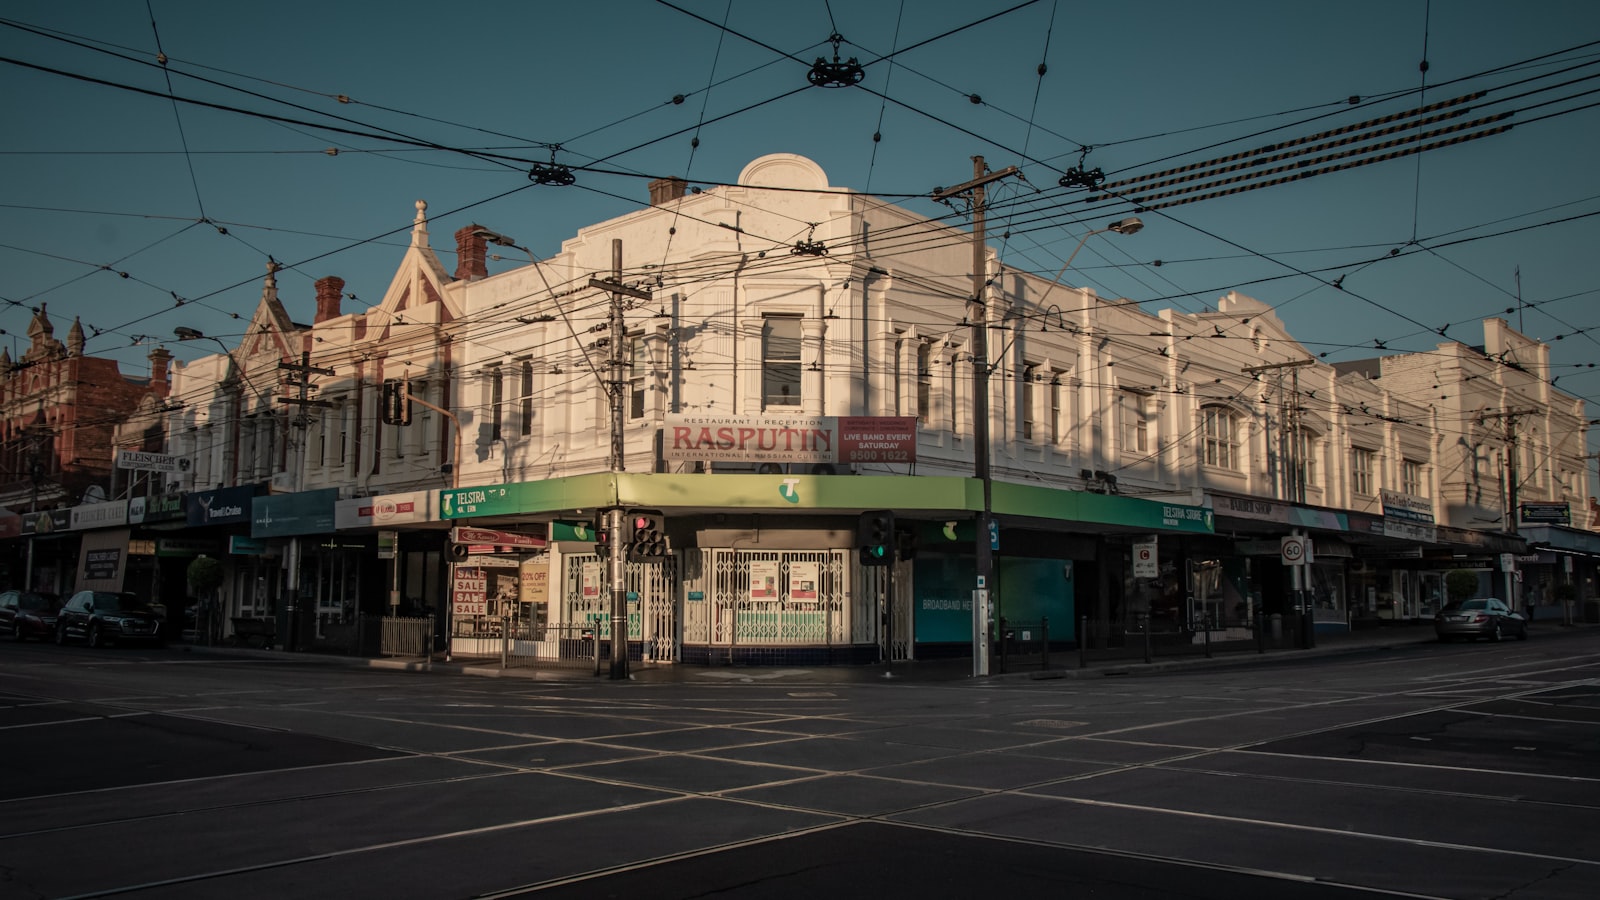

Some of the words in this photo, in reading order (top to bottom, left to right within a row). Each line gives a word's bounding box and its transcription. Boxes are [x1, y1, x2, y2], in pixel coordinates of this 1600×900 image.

[672, 426, 833, 452] RASPUTIN
[844, 433, 861, 441] LIVE
[863, 433, 885, 441] BAND
[886, 433, 912, 441] EVERY
[123, 451, 175, 465] FLEISCHER
[850, 450, 878, 461] 9500
[881, 450, 908, 461] 1622
[457, 490, 487, 505] TELSTRA
[1163, 506, 1186, 520] TELSTRA
[1186, 508, 1203, 521] STORE
[1255, 502, 1272, 515] SHOP
[1286, 545, 1300, 556] 60
[457, 570, 487, 579] SALE
[534, 572, 547, 581] OFF
[457, 582, 485, 590] SALE
[456, 593, 485, 602] SALE
[456, 605, 484, 613] SALE
[922, 599, 961, 611] BROADBAND
